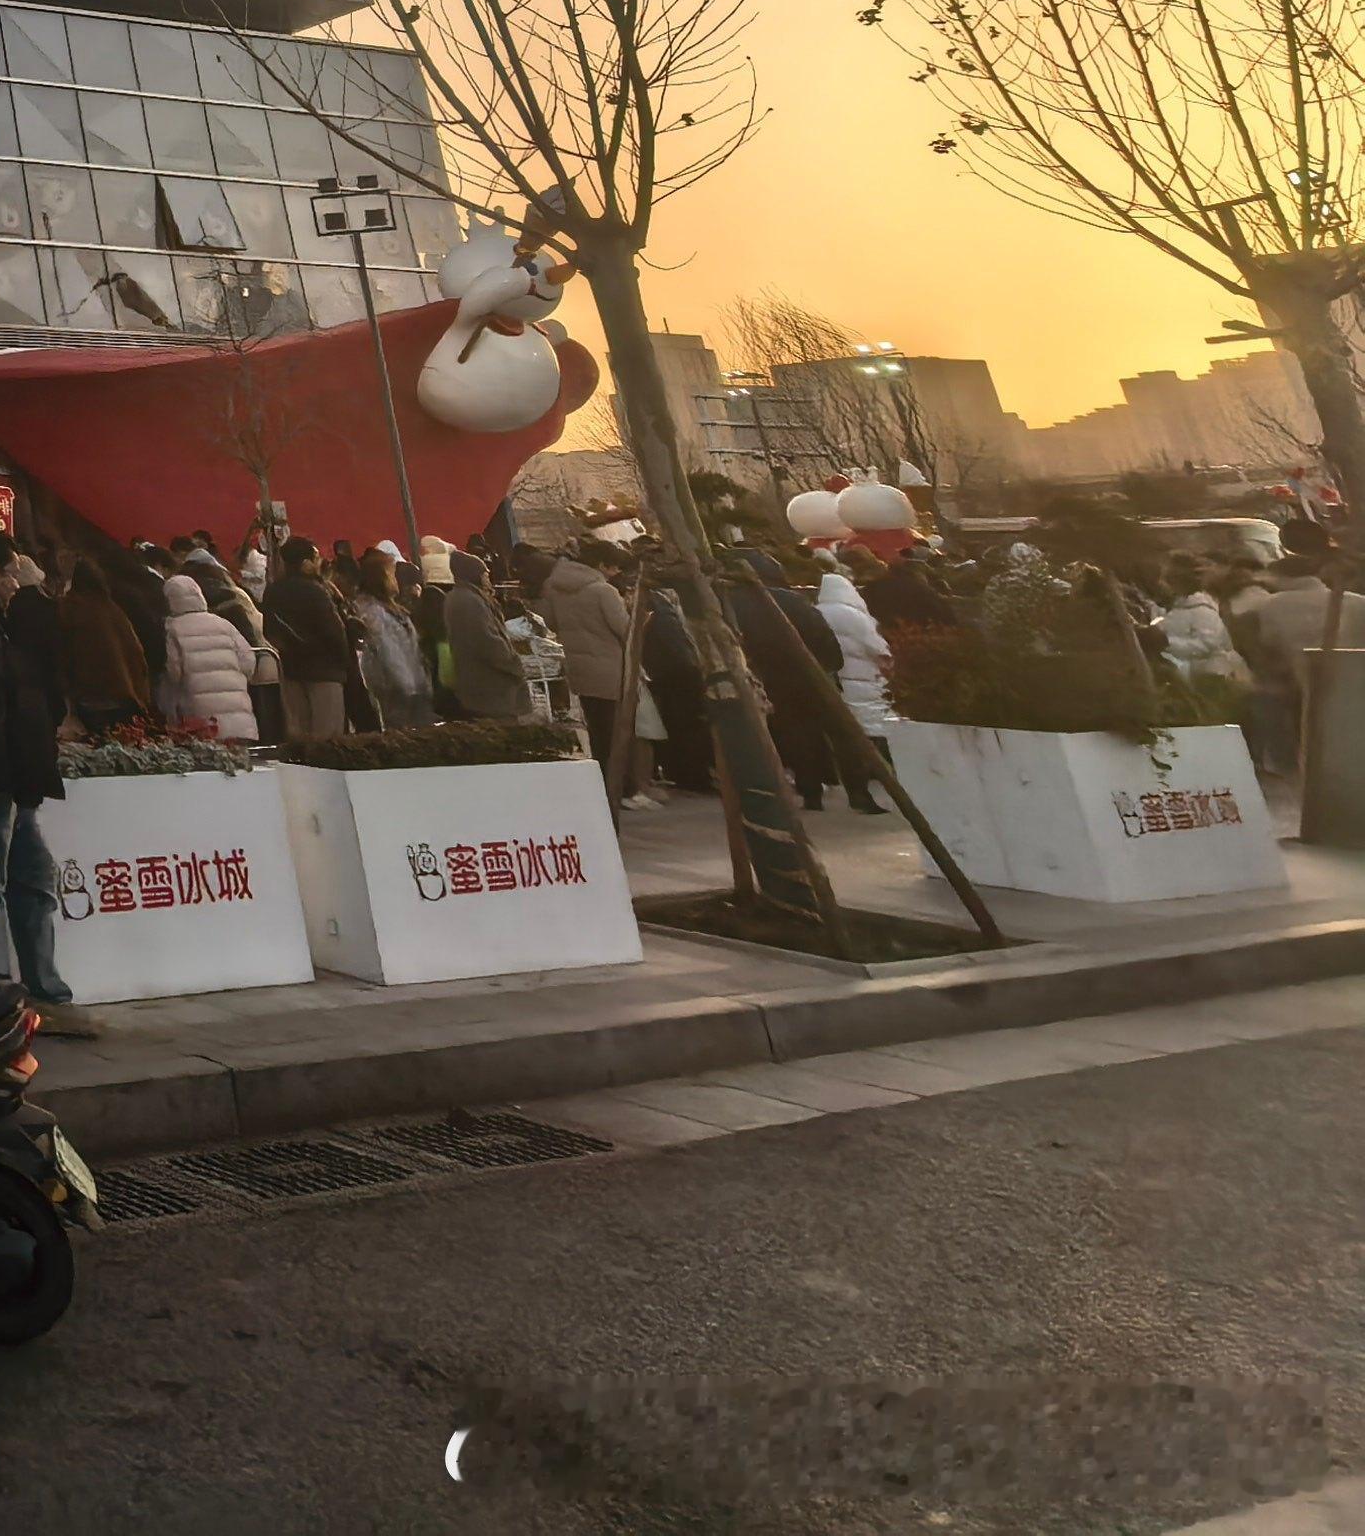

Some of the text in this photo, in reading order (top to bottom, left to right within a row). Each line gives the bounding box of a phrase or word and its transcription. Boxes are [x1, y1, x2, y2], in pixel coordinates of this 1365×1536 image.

[94, 847, 253, 914] 蜜雪冰城
[443, 834, 587, 896] 蜜雪冰城
